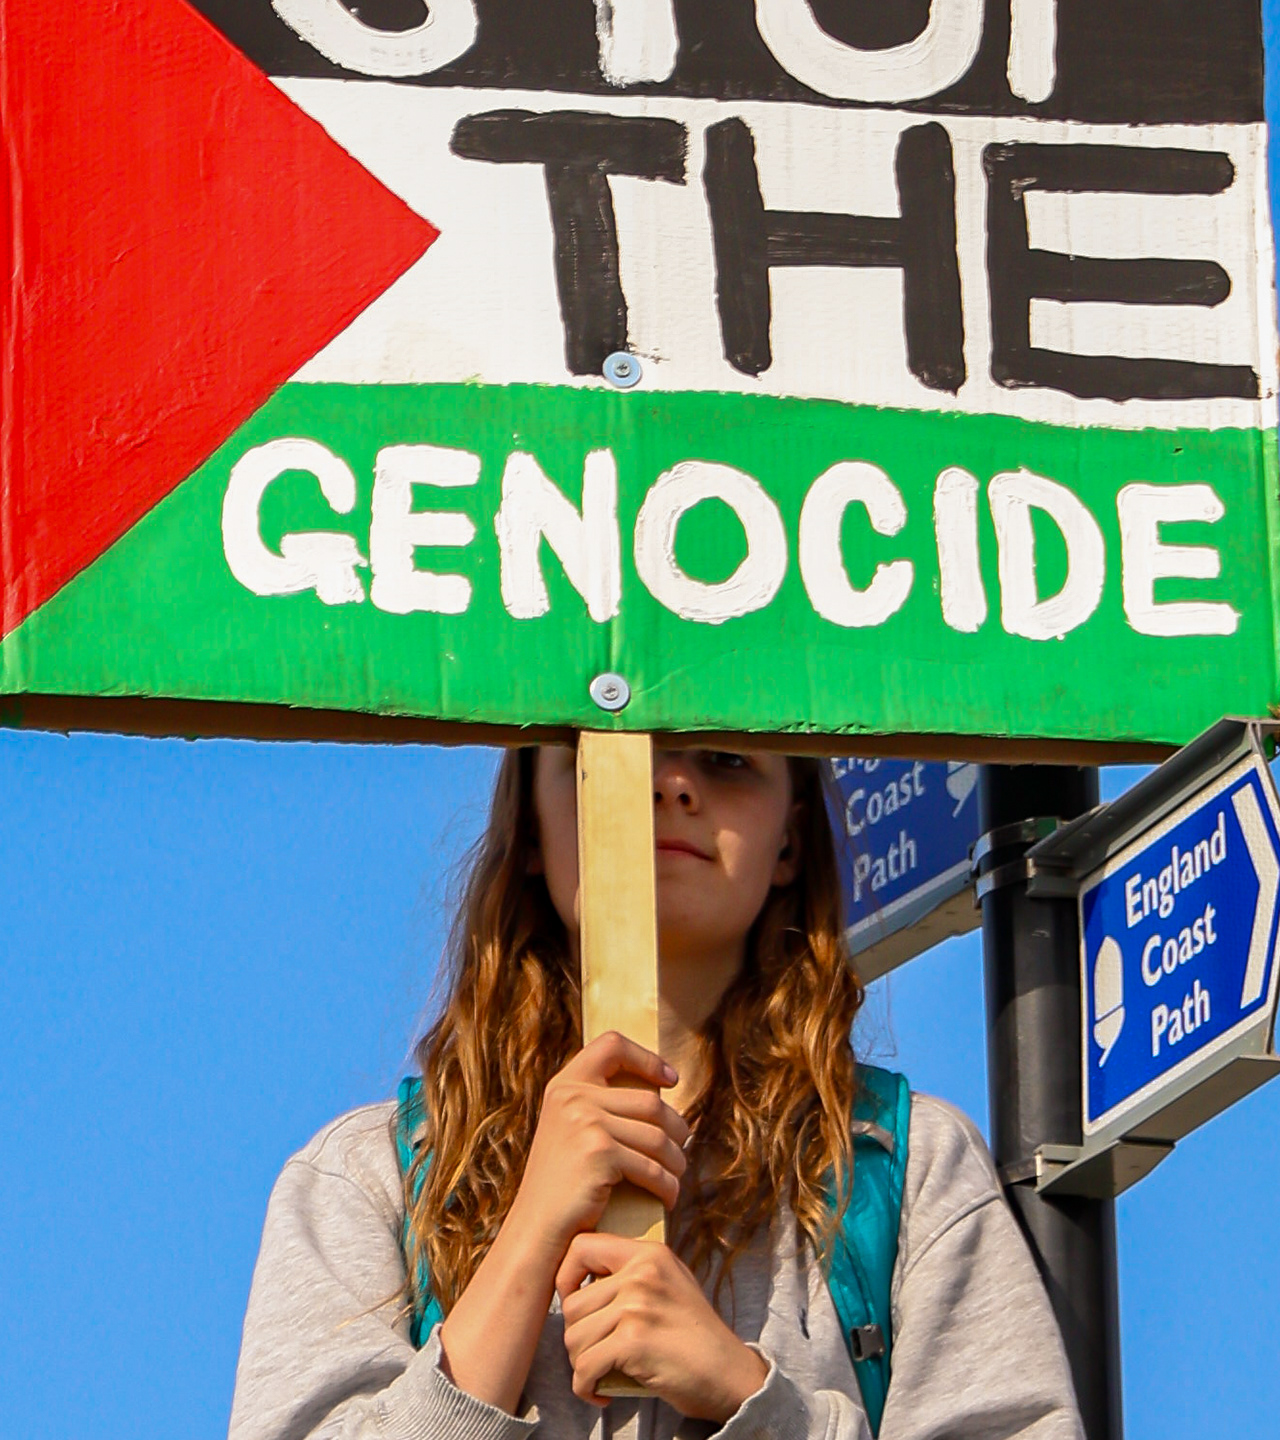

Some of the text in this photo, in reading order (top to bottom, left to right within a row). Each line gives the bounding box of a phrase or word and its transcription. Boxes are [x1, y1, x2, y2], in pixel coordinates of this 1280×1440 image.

[450, 109, 1262, 401] THE
[222, 436, 1243, 642] GENOCIDE
[845, 760, 926, 837] Coast
[853, 829, 917, 903] Path
[1125, 811, 1228, 929] England
[1141, 902, 1218, 987] Coast
[1150, 980, 1211, 1058] Path
